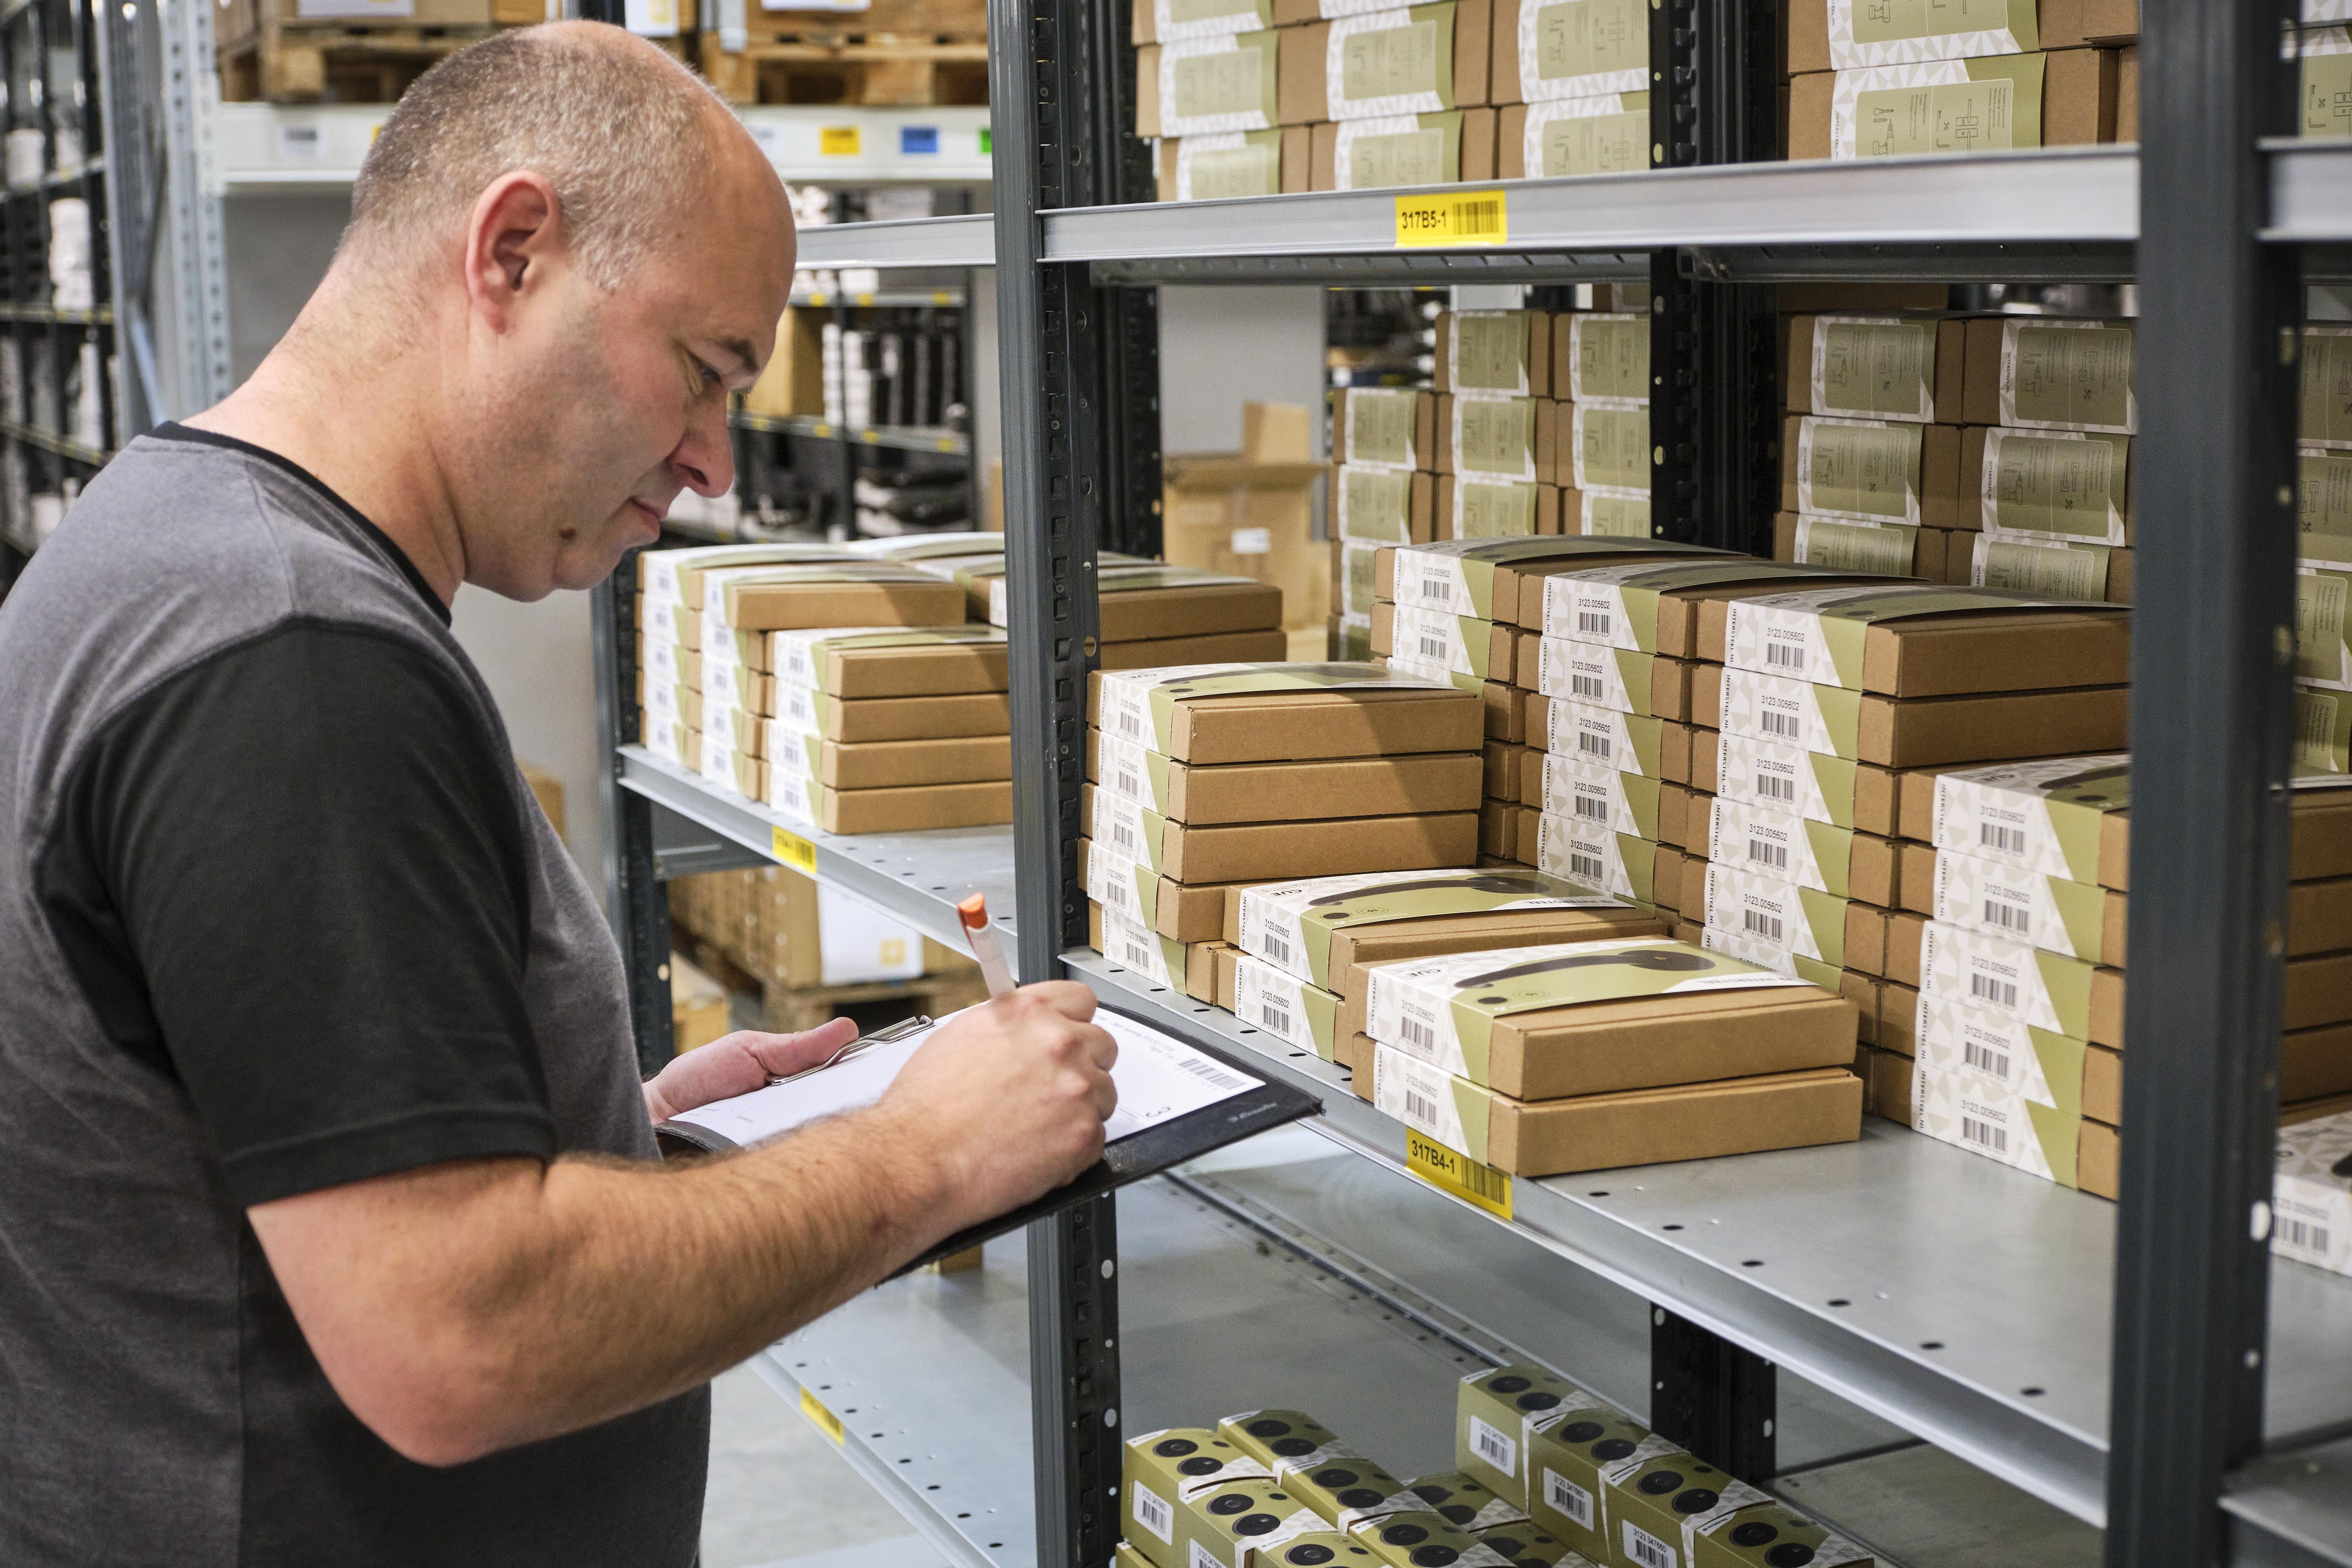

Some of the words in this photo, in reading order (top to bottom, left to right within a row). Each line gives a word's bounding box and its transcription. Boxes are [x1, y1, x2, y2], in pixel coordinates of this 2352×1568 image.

[1402, 209, 1446, 229] 317B5-1
[1423, 567, 1450, 578] 3123.005602
[1578, 598, 1610, 609] 3123.005602
[1767, 628, 1805, 642] 3123.005602
[1572, 661, 1603, 674] 3123.005602
[1120, 698, 1141, 714] 3123.005602
[1761, 695, 1800, 711] 3123.005602
[1579, 718, 1610, 733] 3123.005602
[1756, 759, 1794, 774] 3123.005602
[1574, 782, 1607, 796] 3123.005602
[1114, 810, 1134, 826] 3123.005602
[1980, 805, 2026, 824] 3123.005602
[1749, 824, 1787, 841] 3123.005602
[1570, 840, 1602, 855] 3123.005602
[1107, 868, 1126, 883] 3123.005602
[1984, 882, 2031, 904] 3123.005602
[1744, 894, 1783, 913] 3123.005602
[1264, 918, 1290, 939] 3123.005602
[1125, 929, 1148, 946] 3123.005602
[1406, 969, 1441, 978] CUE
[1971, 956, 2018, 978] 3123.005602
[1262, 990, 1289, 1009] 3123.005602
[1401, 1000, 1435, 1023] 3123.005602
[1965, 1025, 2011, 1049] 3123.005602
[1406, 1073, 1438, 1099] 3123.005602
[1961, 1100, 2008, 1123] 3123.005602
[1412, 1140, 1455, 1175] 317B4-1
